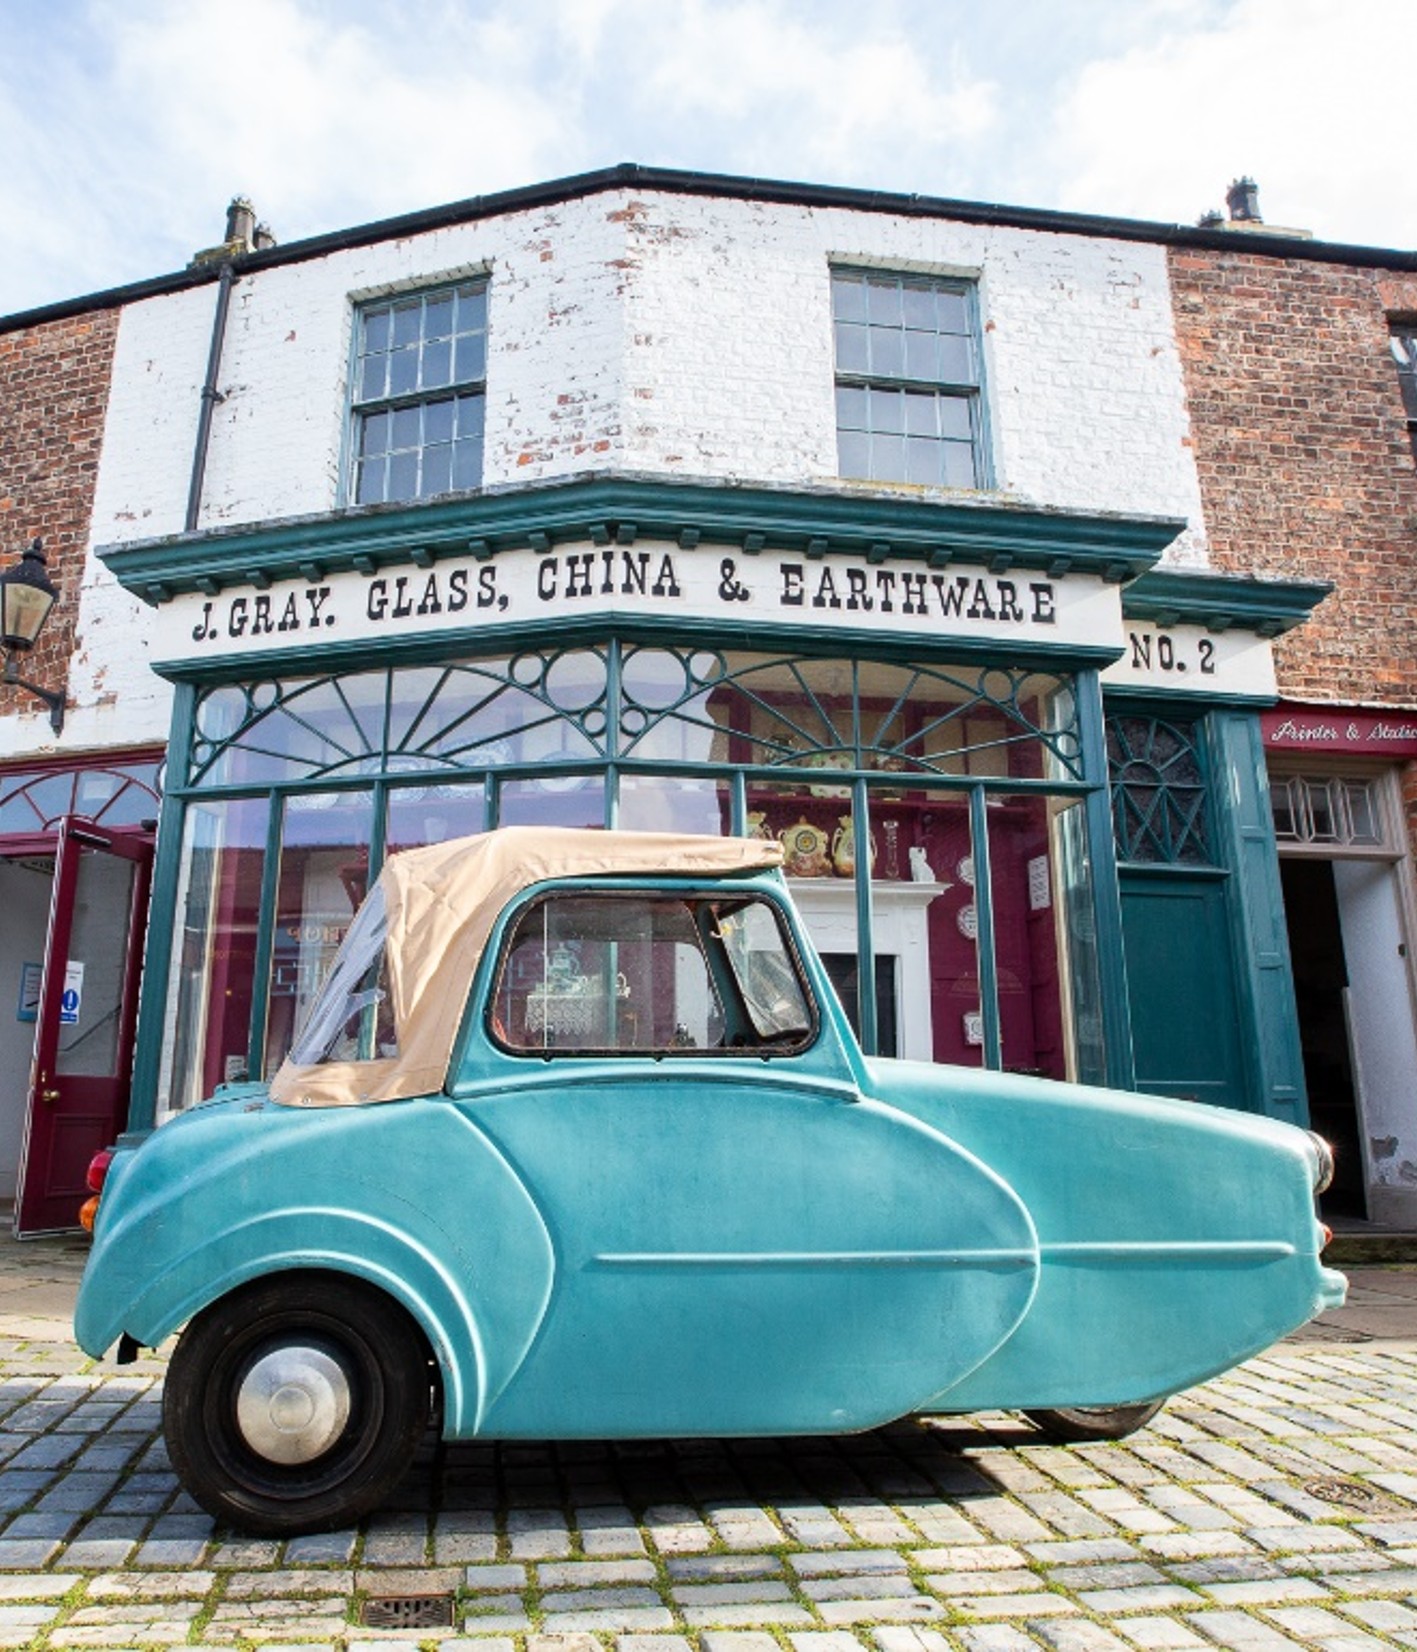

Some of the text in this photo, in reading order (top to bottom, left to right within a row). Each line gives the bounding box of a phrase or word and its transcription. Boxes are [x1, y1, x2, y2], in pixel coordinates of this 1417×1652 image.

[367, 565, 509, 621] GLASS,
[537, 550, 681, 601] CHINA
[718, 557, 750, 602] &
[780, 563, 1055, 624] EARTHWARE
[1271, 718, 1339, 742] Printer
[1346, 722, 1360, 741] &
